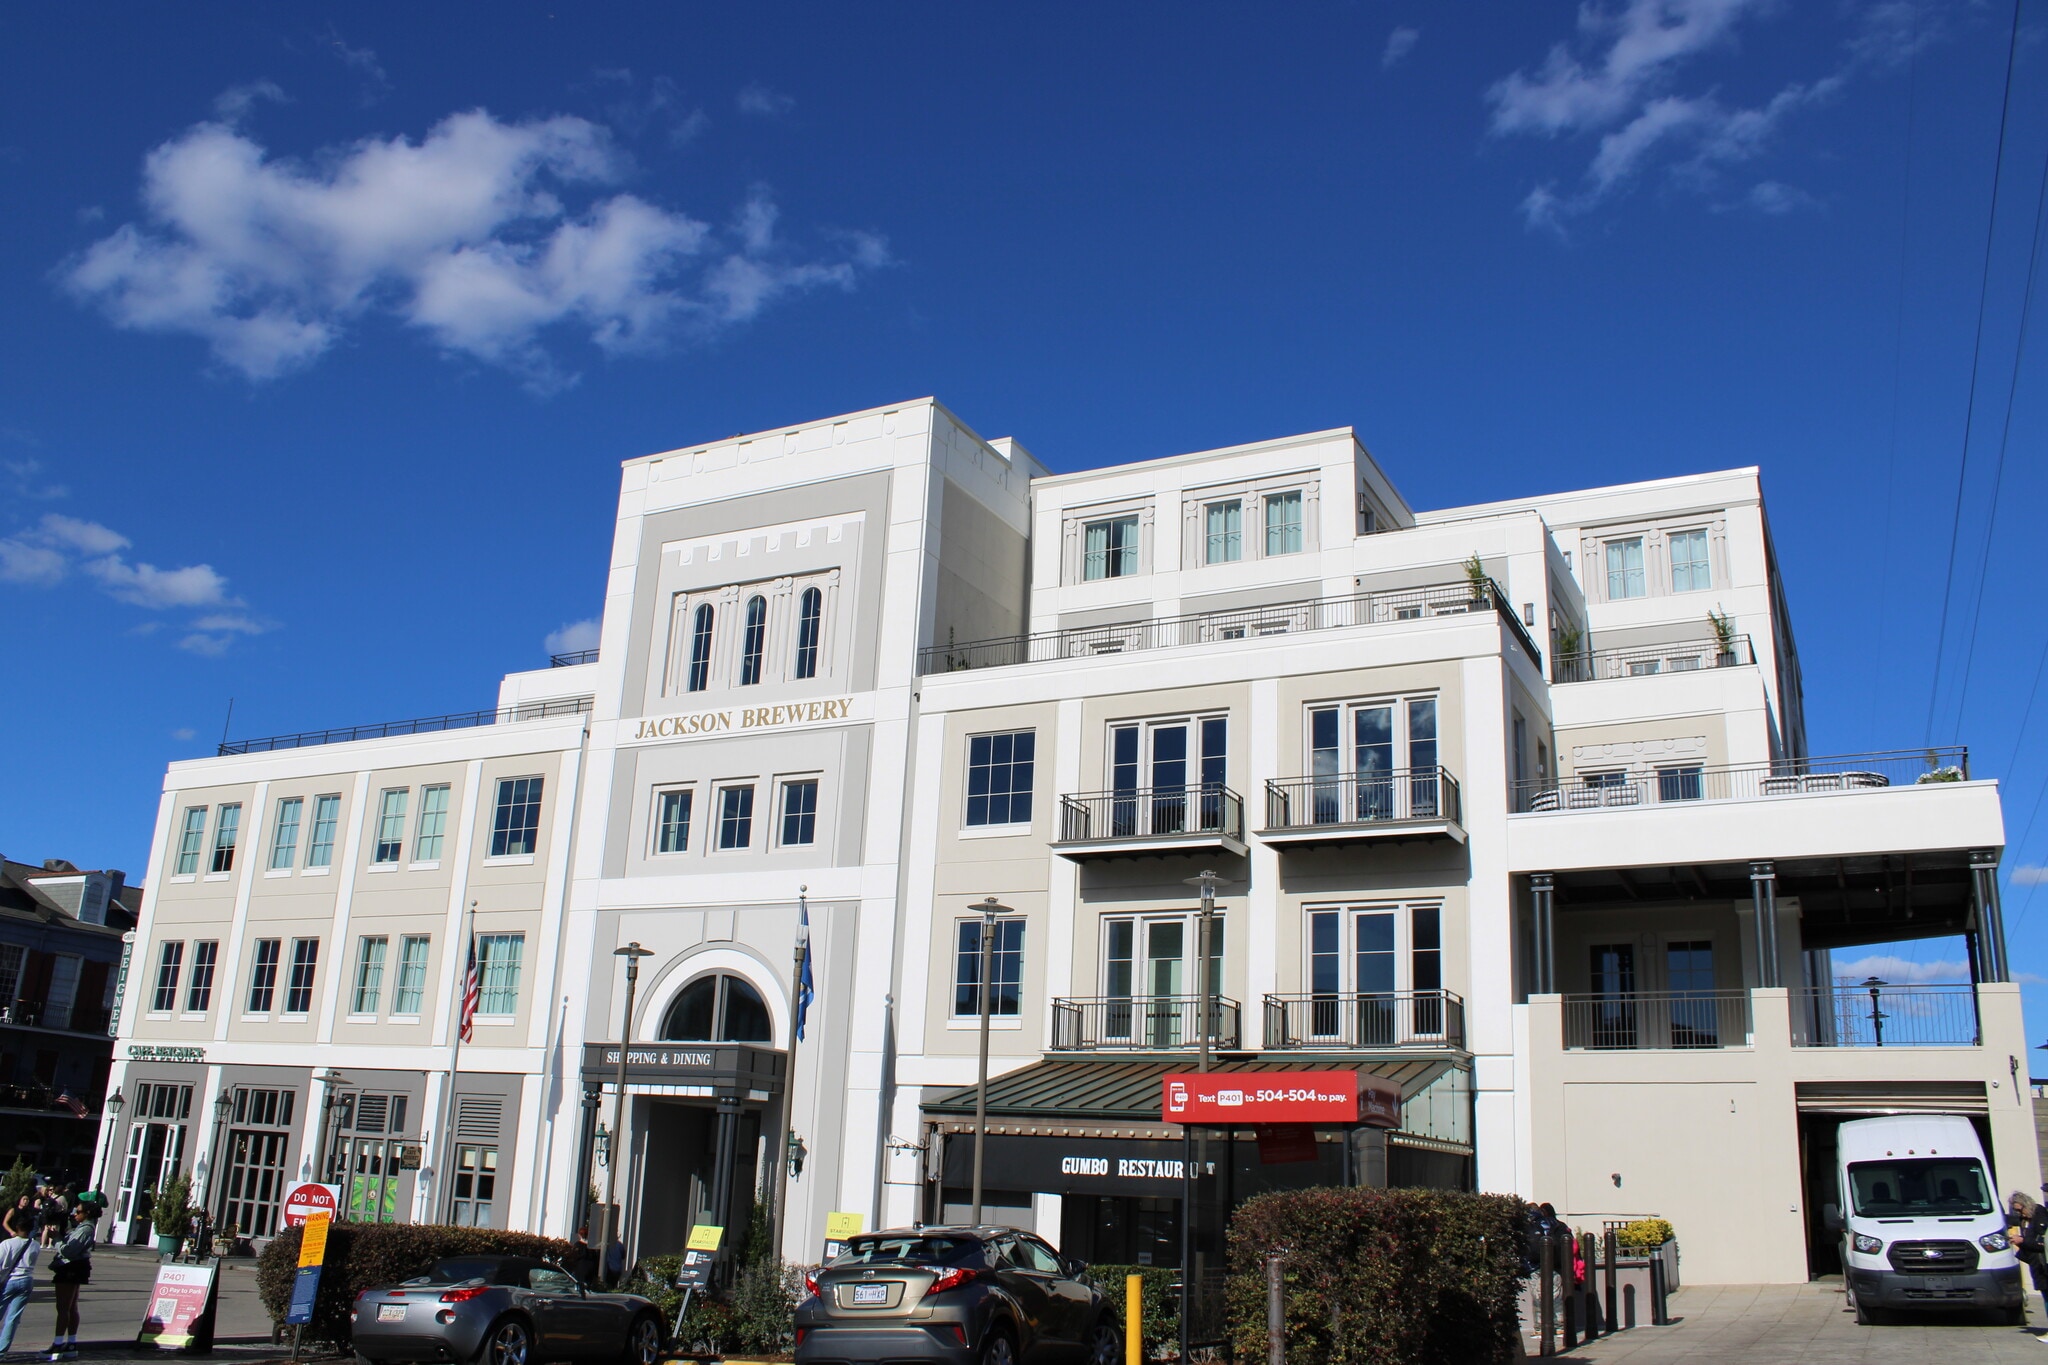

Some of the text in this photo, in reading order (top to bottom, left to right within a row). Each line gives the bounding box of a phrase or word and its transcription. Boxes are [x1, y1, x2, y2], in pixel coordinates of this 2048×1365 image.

[635, 698, 853, 739] JACKSON BREWERY
[110, 944, 132, 1033] BEIGNET
[606, 1051, 711, 1065] SHPPING & DINING
[1198, 1089, 1347, 1103] Text P401 to 504-504 to pay.
[1062, 1157, 1108, 1175] GUMBO
[294, 1193, 331, 1205] DO NOT
[163, 1273, 185, 1281] P401
[169, 1287, 180, 1295] Pay
[855, 1290, 867, 1300] 561
